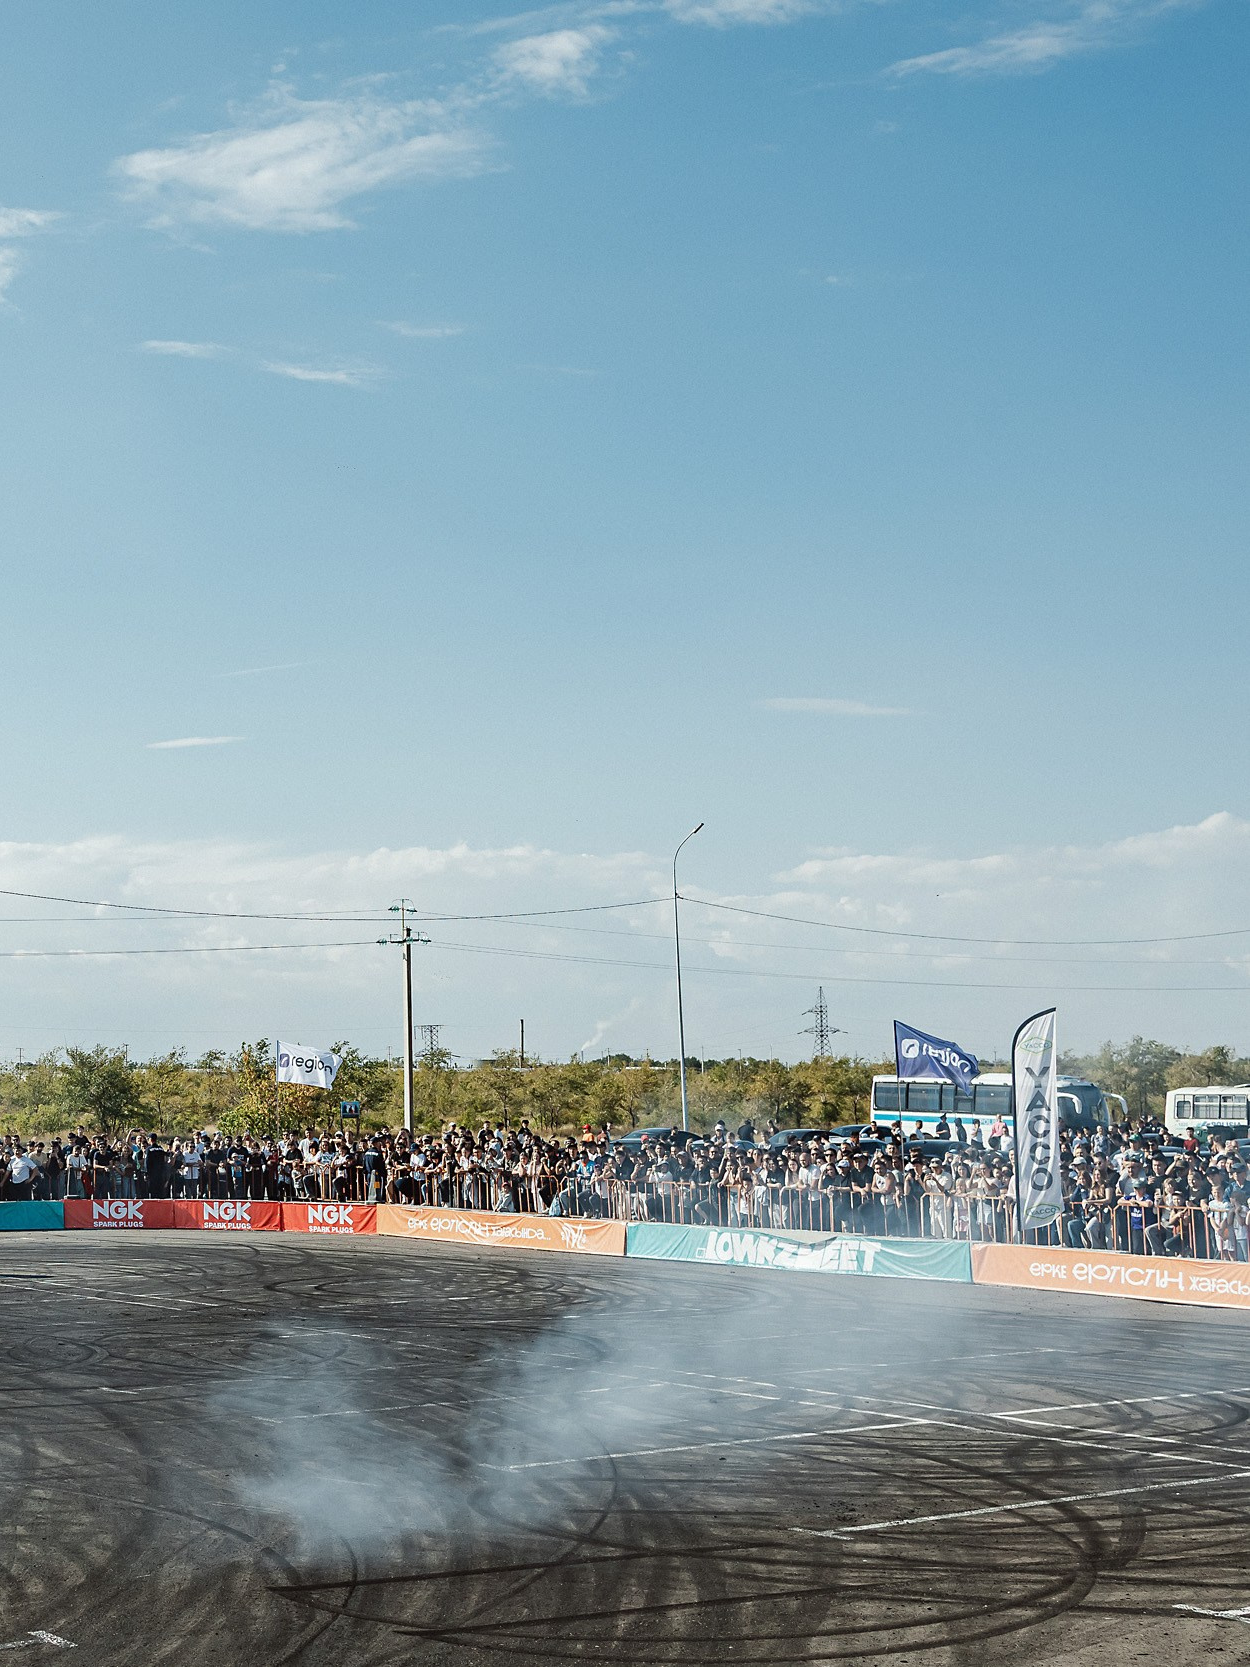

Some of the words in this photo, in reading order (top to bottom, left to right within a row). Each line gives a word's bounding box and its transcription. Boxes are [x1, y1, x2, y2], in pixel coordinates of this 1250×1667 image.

[291, 1056, 333, 1076] region
[1024, 1066, 1054, 1192] YACCO
[93, 1200, 144, 1220] NGK
[203, 1201, 252, 1222] NGK
[307, 1204, 354, 1226] NGK
[308, 1225, 331, 1233] SPARK
[331, 1226, 354, 1234] PLUGS
